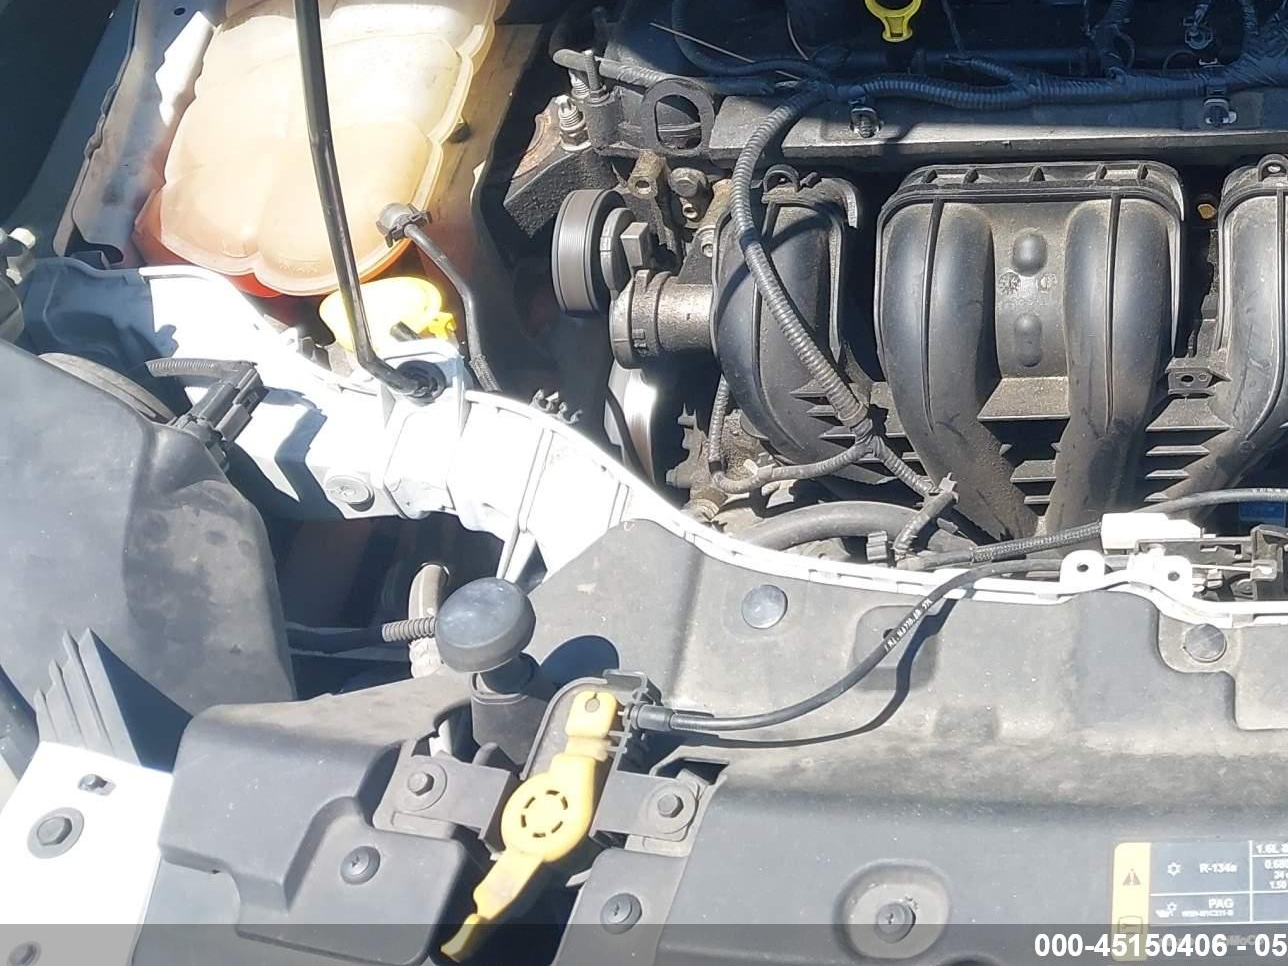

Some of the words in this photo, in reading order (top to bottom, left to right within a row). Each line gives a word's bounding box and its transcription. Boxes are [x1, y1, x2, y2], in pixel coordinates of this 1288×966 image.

[1256, 844, 1280, 854] 1.6L
[1199, 862, 1238, 874] R-134a
[1208, 898, 1234, 909] PAG
